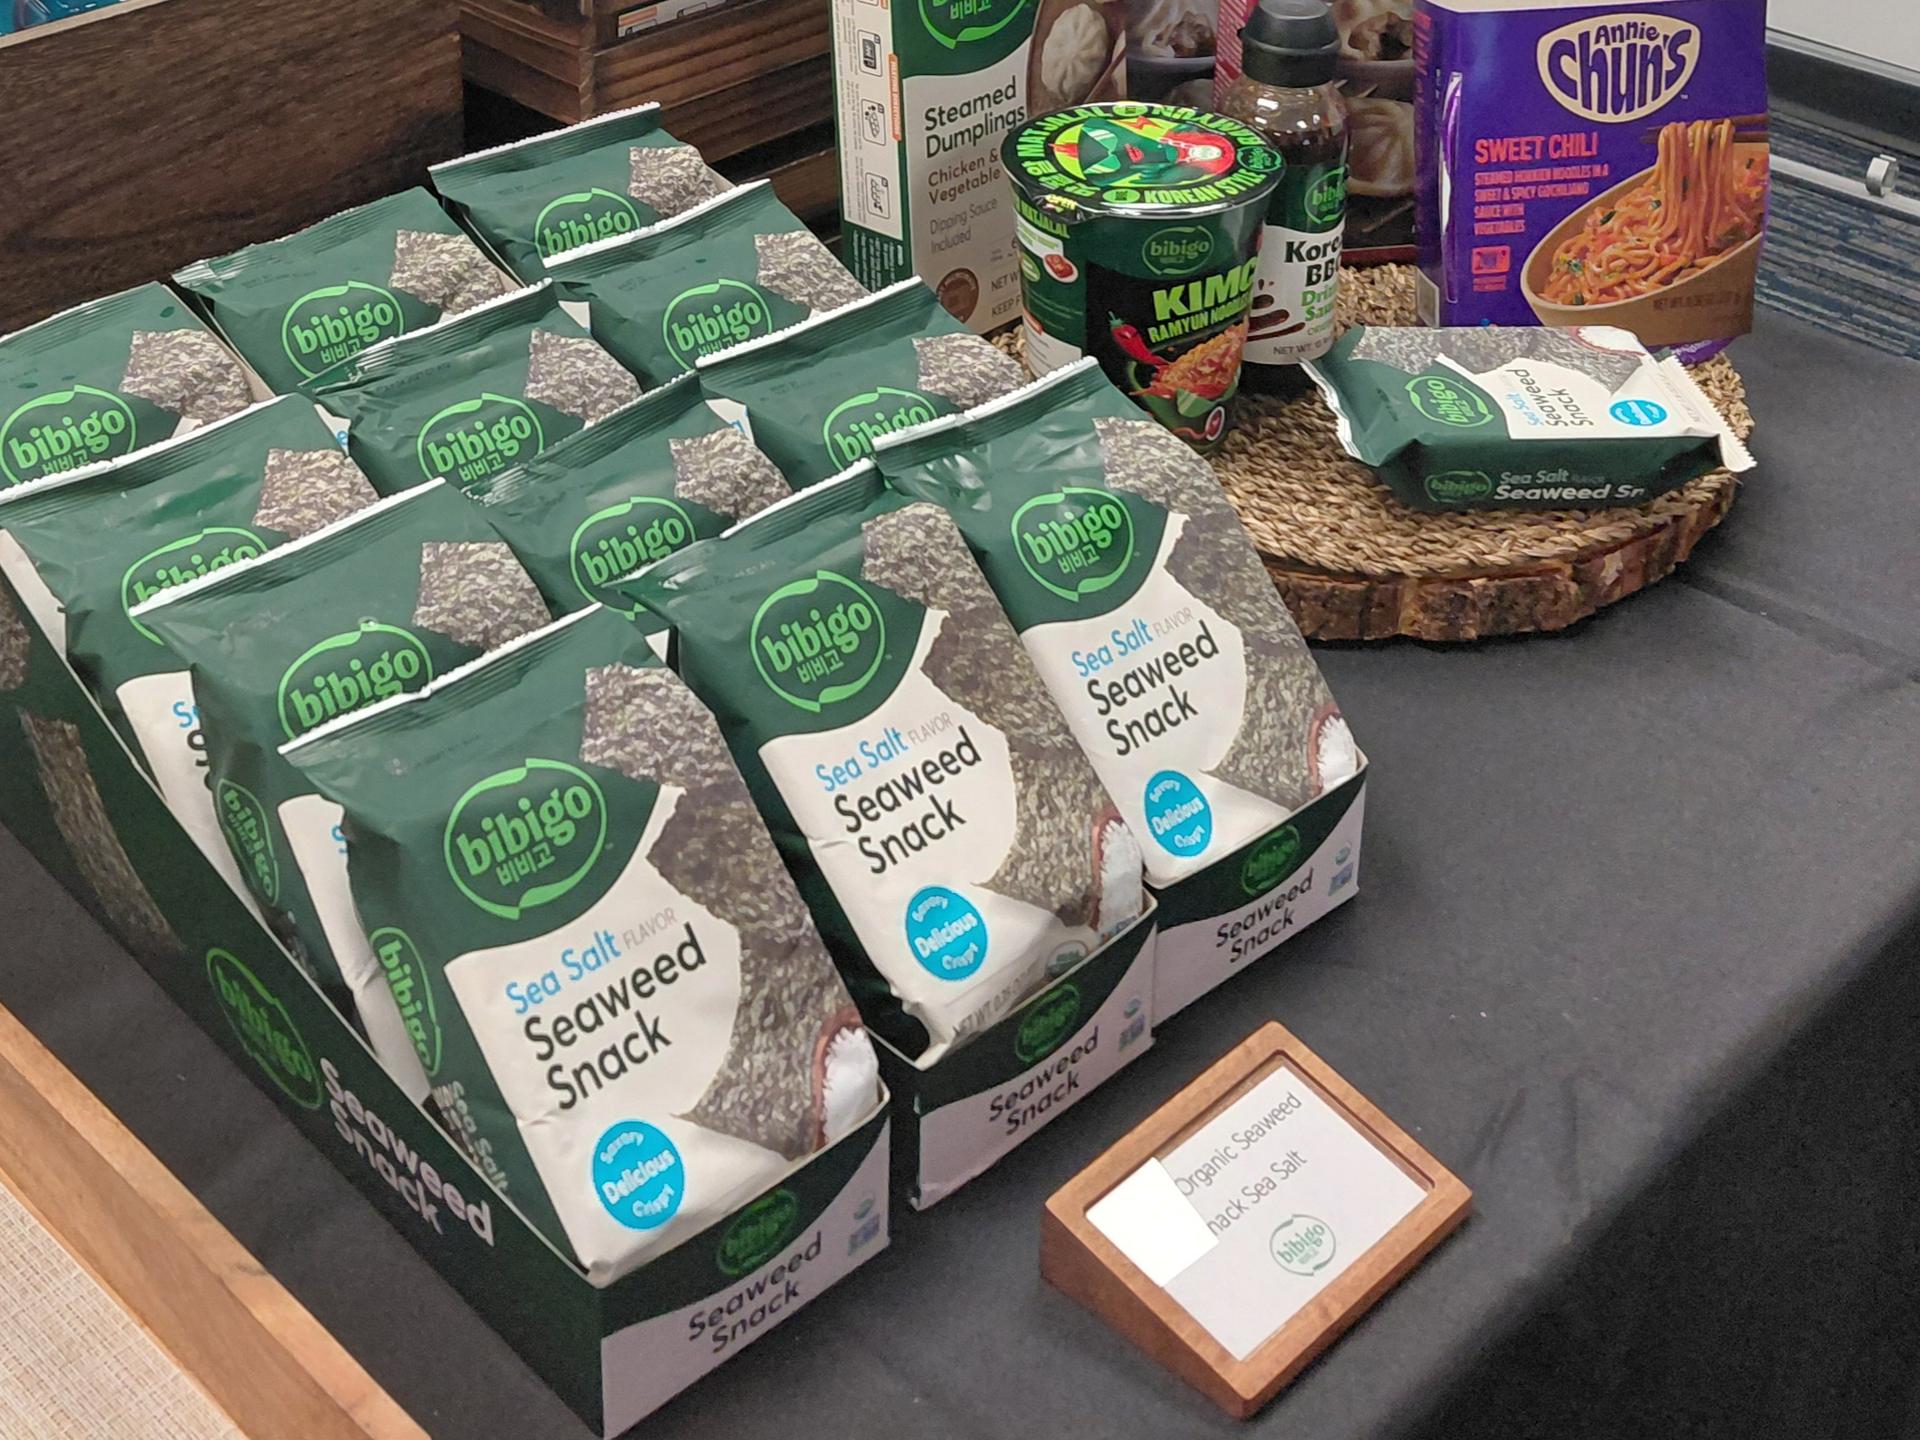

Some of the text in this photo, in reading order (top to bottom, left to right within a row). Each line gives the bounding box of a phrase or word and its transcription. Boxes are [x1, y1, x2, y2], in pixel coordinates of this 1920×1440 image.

[1593, 21, 1660, 47] Annie
[1547, 28, 1692, 116] Chun's
[925, 75, 1016, 131] Steamed
[926, 105, 1025, 158] Dumplings
[1474, 132, 1599, 164] SWEET CHILI
[928, 147, 999, 187] Chicken &
[928, 167, 1001, 204] Vegetable
[1142, 168, 1267, 205] KOREAN STYLE
[543, 210, 632, 255] bibigo
[930, 198, 998, 235] Dipping Sauce
[1150, 239, 1209, 259] bibigo
[1304, 252, 1341, 287] BB
[291, 303, 394, 354] bibigo
[671, 302, 762, 352] bibigo
[1148, 311, 1210, 343] RAMYUN
[1427, 379, 1469, 423] bibigo
[1505, 368, 1569, 427] Seaweed
[1506, 391, 1545, 427] Sea Salt
[1547, 387, 1594, 427] Snack
[8, 410, 126, 470] bibigo
[427, 415, 532, 473] bibigo
[458, 451, 506, 483] 비비고
[1493, 483, 1612, 500] Seaweed
[1500, 472, 1532, 484] Sea
[1535, 468, 1570, 484] Salt
[580, 517, 686, 586] bibigo
[1023, 504, 1123, 564] bibigo
[1057, 543, 1100, 574] 비비고
[761, 602, 873, 673] bibigo
[1071, 606, 1195, 677] Sea Salt FLAVOR
[290, 649, 421, 728] bibigo
[796, 648, 845, 684] 비비고
[1087, 619, 1220, 716] Seaweed
[1106, 684, 1199, 756] Snack
[815, 711, 953, 792] Sea Salt FLAVOR
[834, 724, 983, 833] Seaweed
[456, 786, 592, 876] bibigo
[858, 793, 968, 874] Snack
[1151, 796, 1205, 836] Delicious
[495, 841, 556, 887] 비비고
[914, 911, 978, 958] Delicious
[1215, 867, 1314, 948] Seaweed
[1229, 908, 1294, 963] Snack
[505, 906, 678, 1014] Sea Salt FLAVOR
[378, 939, 431, 1069] bibigo
[524, 921, 707, 1062] Seaweed
[547, 1009, 672, 1110] Snack
[989, 1024, 1099, 1122] Seaweed
[1006, 1071, 1080, 1135] Snack
[319, 1057, 495, 1247] Seaweed
[328, 1098, 443, 1236] Snack
[1174, 1092, 1302, 1197] Organic Seaweed
[602, 1149, 675, 1205] Delicious
[1241, 1176, 1277, 1204] Sea
[1270, 1149, 1308, 1180] Salt
[1276, 1222, 1326, 1264] bibigo
[688, 1230, 822, 1342] Seaweed
[711, 1280, 800, 1354] Snack
